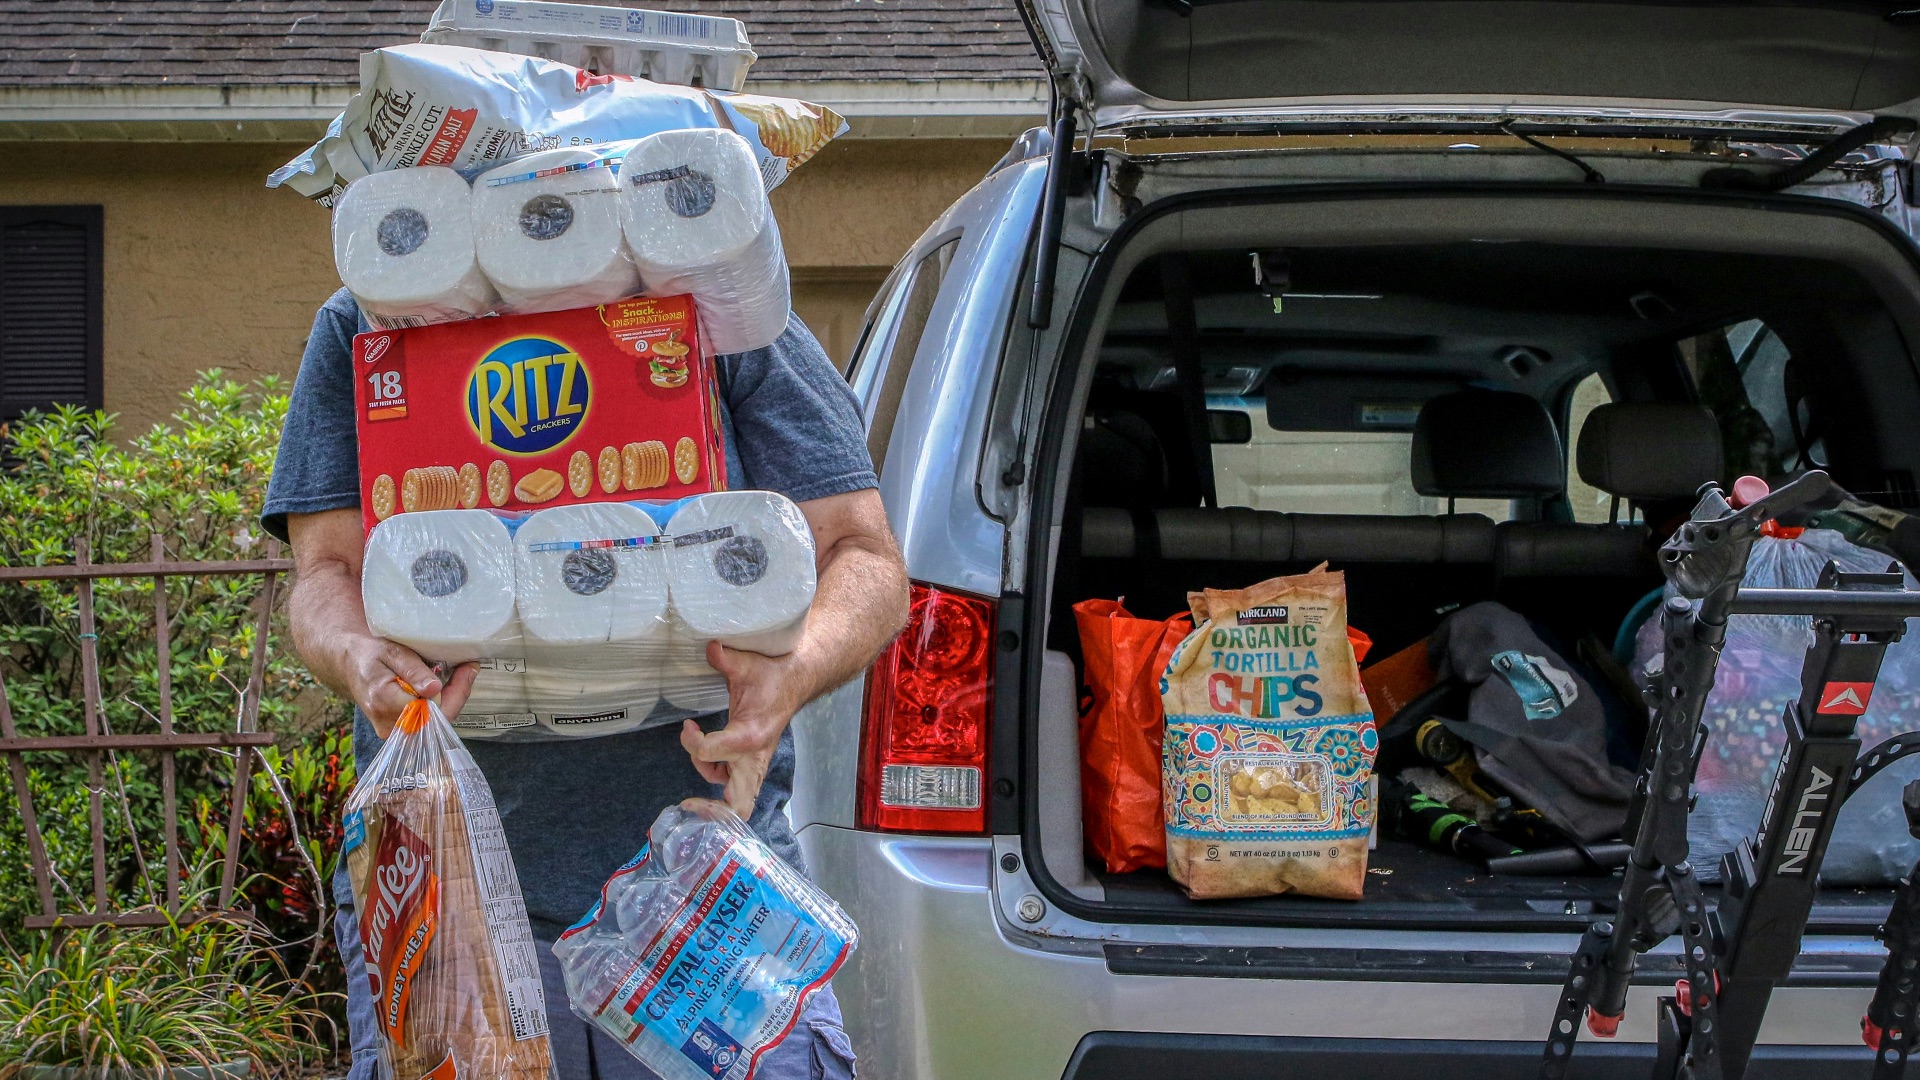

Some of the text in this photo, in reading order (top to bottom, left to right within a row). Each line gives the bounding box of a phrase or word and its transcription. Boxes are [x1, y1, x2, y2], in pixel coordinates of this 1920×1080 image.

[393, 123, 415, 152] BRAND
[442, 115, 463, 138] SALT
[451, 129, 467, 153] CHIPS
[482, 128, 507, 159] PROMISE
[612, 310, 685, 328] INSPIRATIONS!
[623, 306, 655, 318] Snack
[366, 337, 388, 361] NABISCO
[368, 370, 403, 400] 18
[475, 352, 582, 444] RITZ
[530, 417, 571, 433] CRACKERS
[1239, 608, 1287, 619] KIRKLAND
[1211, 624, 1317, 649] ORGANIC
[1211, 650, 1319, 673] TORTILLA
[1208, 672, 1323, 719] CHIPS
[557, 714, 622, 725] KIRKLAND
[1777, 765, 1834, 875] ALLEN
[1270, 850, 1277, 858] (2
[376, 845, 425, 924] Lee
[643, 954, 672, 991] BOTTLED
[672, 940, 682, 952] AT
[683, 921, 698, 937] THE
[697, 884, 722, 919] SOURCE
[645, 951, 706, 1021] CRYSTAL
[696, 880, 756, 952] GEYSER
[388, 920, 430, 1028] HONEY WHEAT
[675, 988, 713, 1034] ALPINE
[707, 945, 744, 992] SPRING
[737, 905, 771, 947] WATER
[685, 926, 743, 1000] NATURAL
[617, 974, 640, 1001] CRYSTAL
[720, 958, 752, 998] BY CG ROXANE
[508, 990, 521, 1037] Nutrition
[517, 1008, 527, 1036] Facts
[692, 1031, 713, 1051] 6
